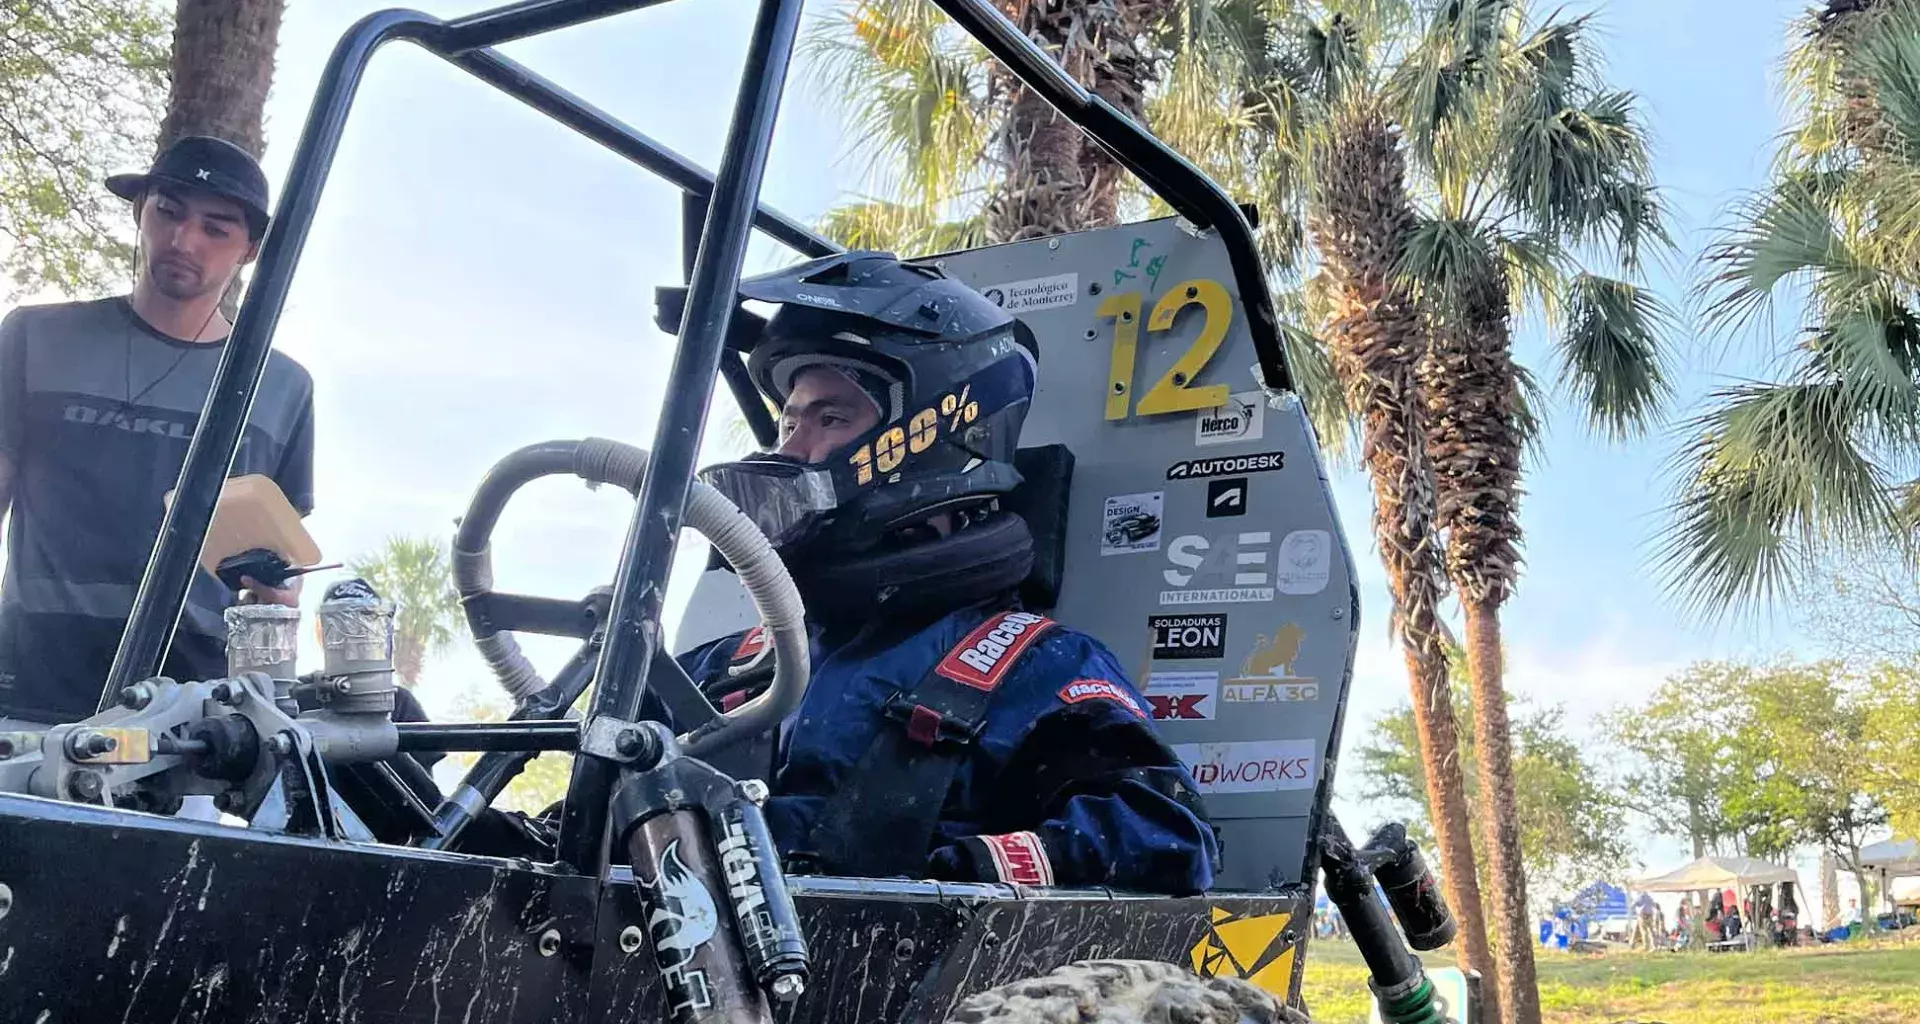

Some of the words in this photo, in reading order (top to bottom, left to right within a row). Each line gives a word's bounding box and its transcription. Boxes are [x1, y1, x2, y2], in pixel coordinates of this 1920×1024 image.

[1009, 283, 1068, 298] Tecnológico
[1007, 299, 1020, 309] de
[1021, 293, 1076, 308] Monterrey
[1096, 278, 1233, 420] 12
[63, 404, 215, 441] OAKL
[1201, 417, 1239, 433] Herco
[849, 382, 979, 485] 100%
[1191, 454, 1281, 476] AUTODESK
[1107, 505, 1140, 517] DESIGN
[1162, 589, 1267, 603] INTERNATIONAL
[1154, 617, 1221, 628] SOLDADURAS
[1153, 626, 1220, 648] LEON
[1224, 685, 1280, 701] ALFA
[1285, 686, 1317, 700] 3C
